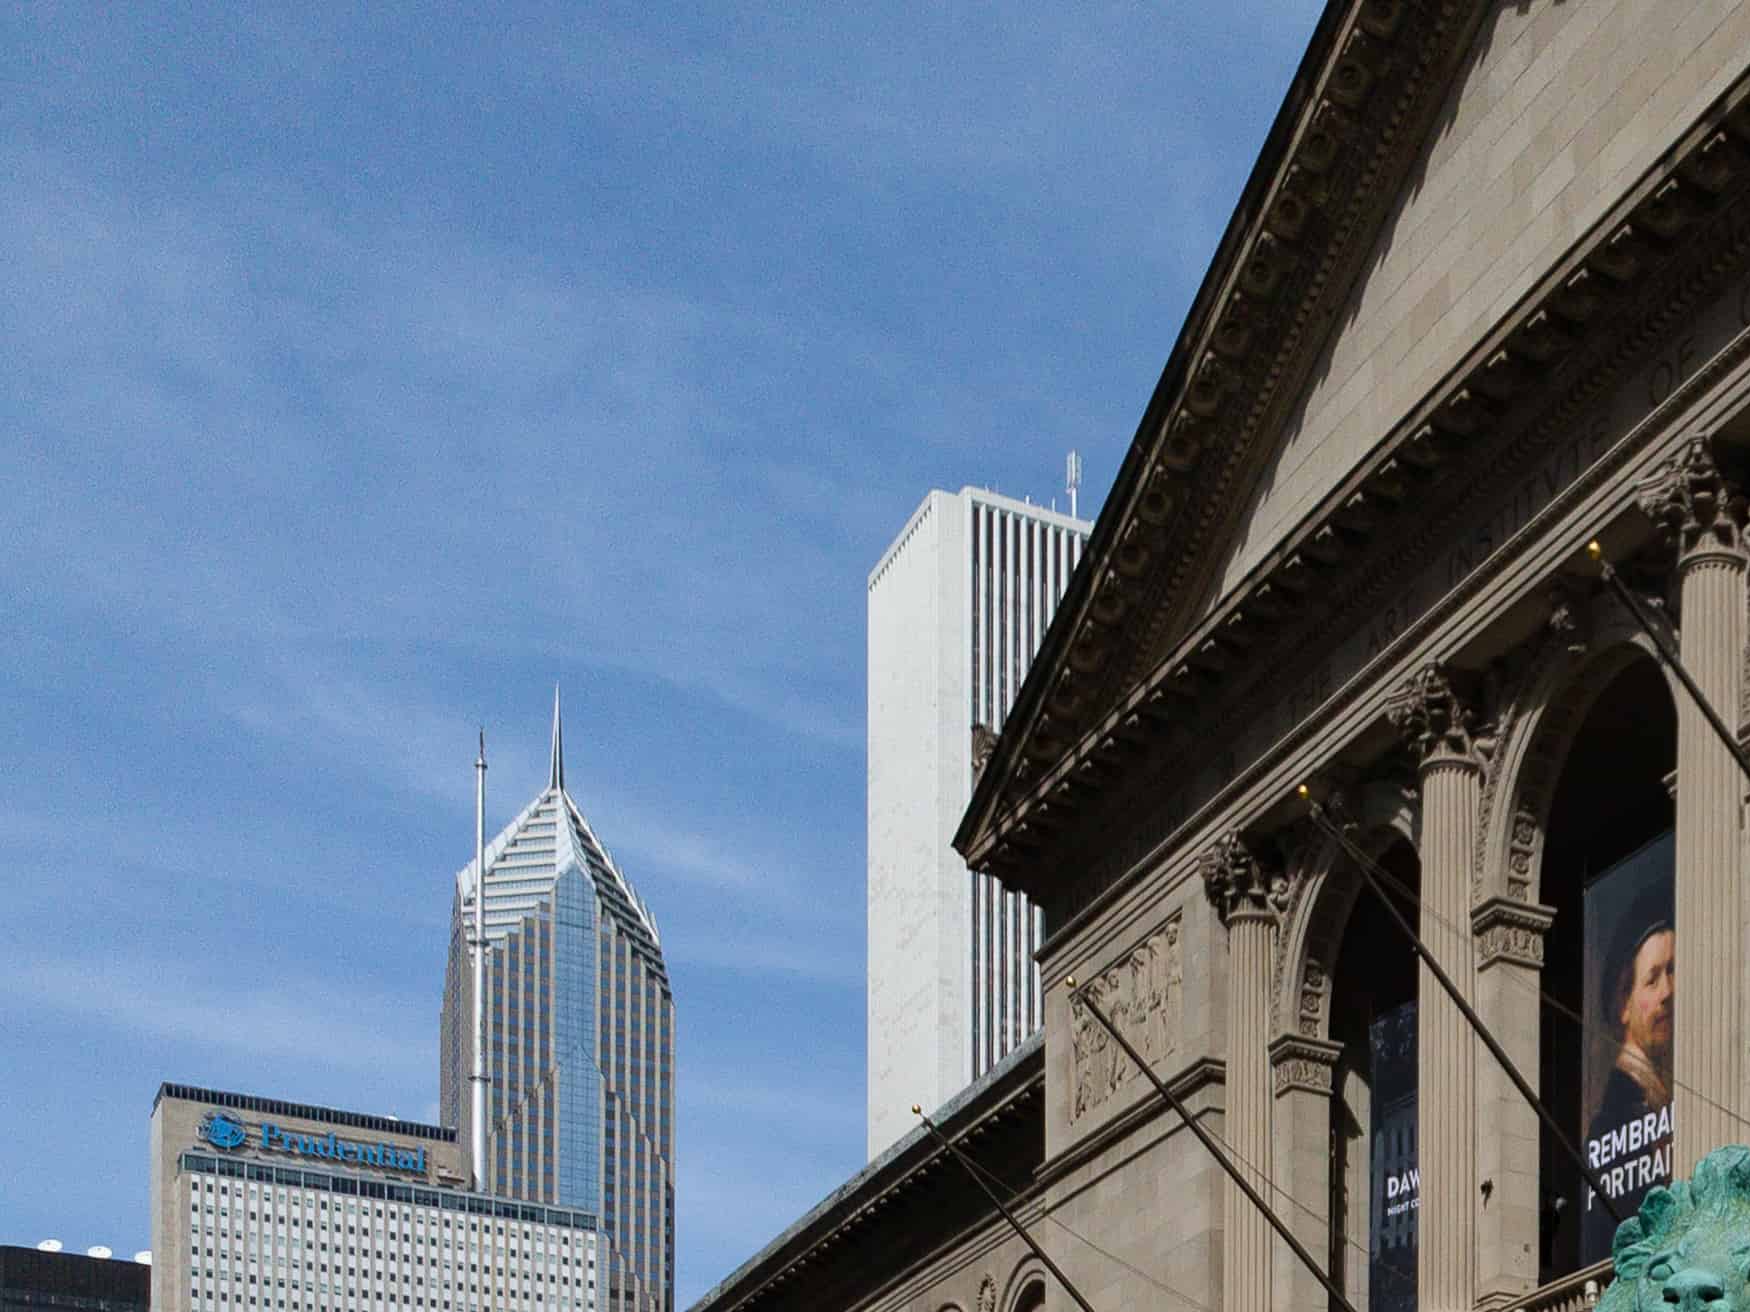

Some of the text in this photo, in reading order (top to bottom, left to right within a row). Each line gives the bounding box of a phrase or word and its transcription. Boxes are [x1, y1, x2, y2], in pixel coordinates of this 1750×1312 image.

[1649, 335, 1700, 405] OF
[261, 1121, 427, 1172] Prudential
[1588, 1143, 1674, 1211] PORTRAI
